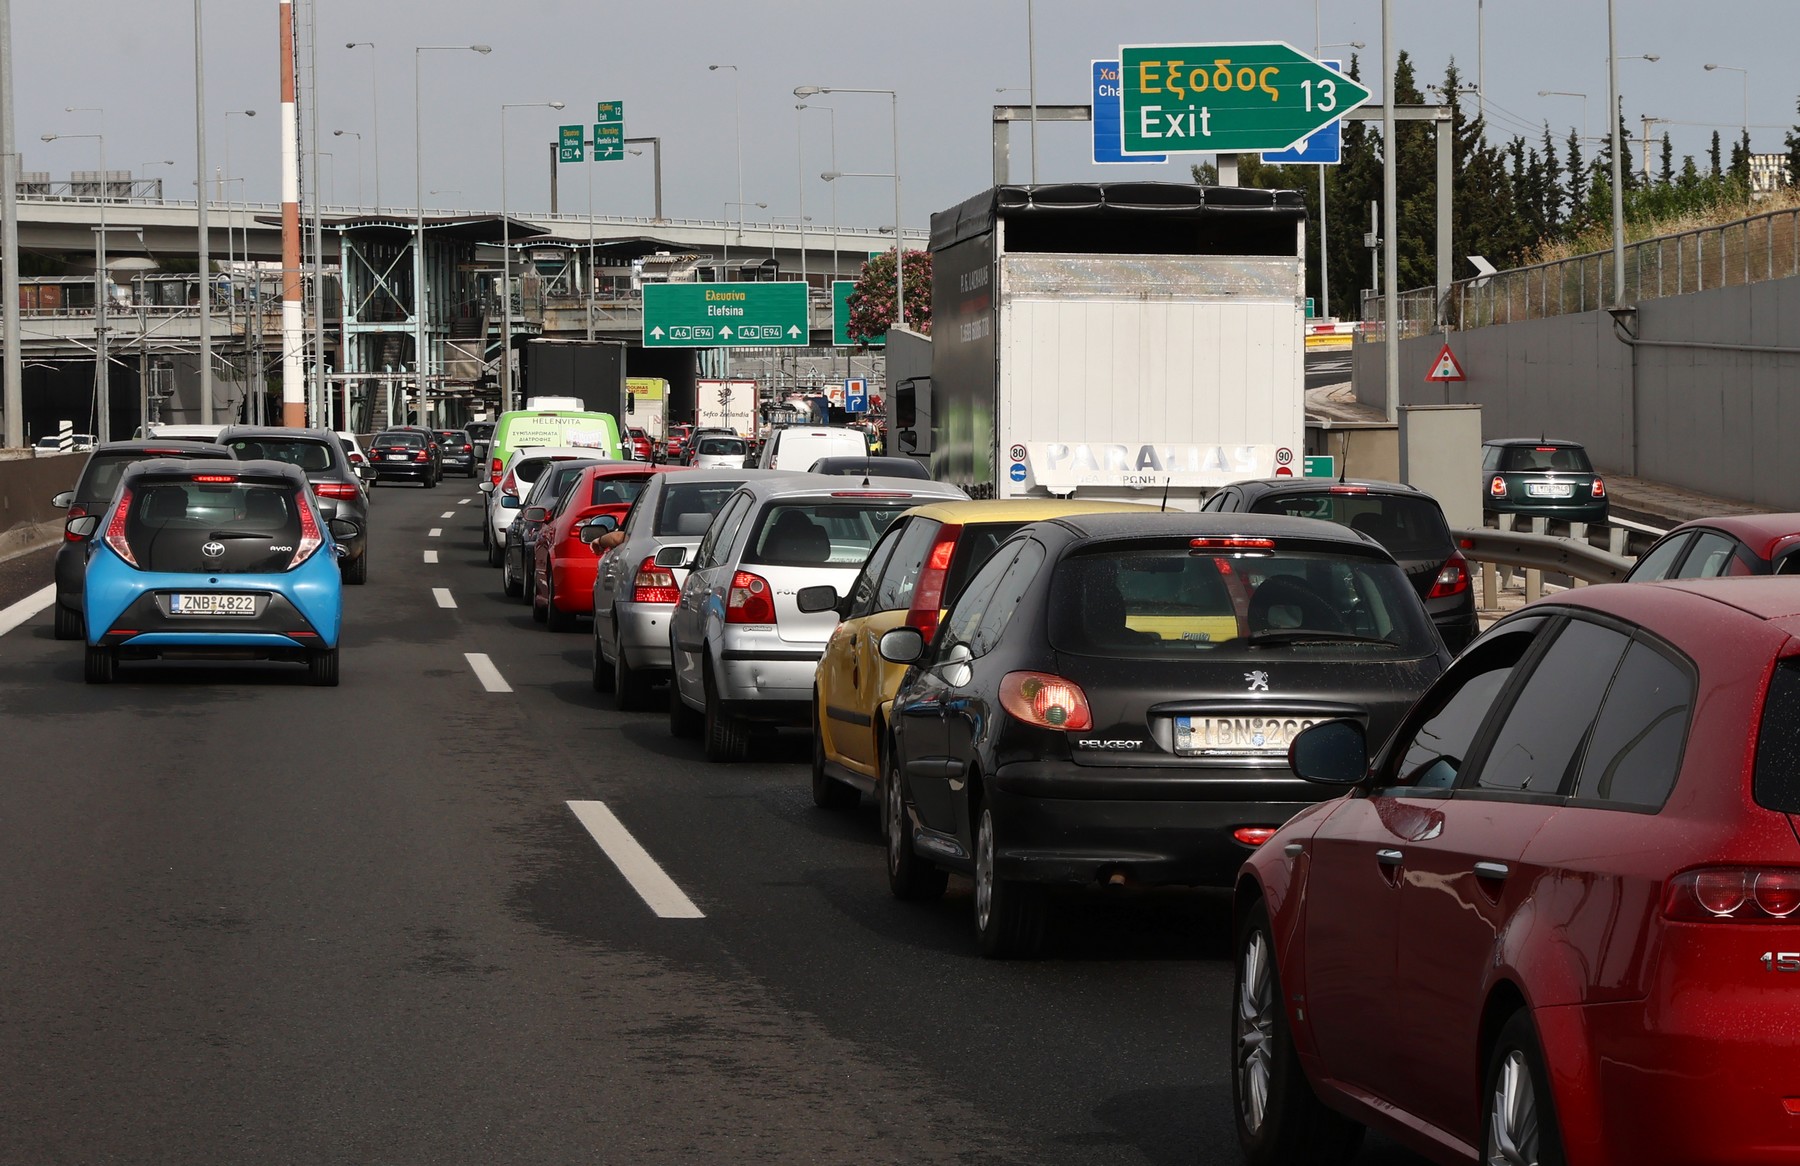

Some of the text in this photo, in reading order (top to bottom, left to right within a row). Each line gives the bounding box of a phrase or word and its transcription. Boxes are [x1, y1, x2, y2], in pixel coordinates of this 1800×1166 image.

[1139, 59, 1280, 102] Εξοδος
[1300, 79, 1337, 113] 13
[615, 107, 621, 115] 12
[1140, 105, 1212, 138] Exit
[705, 289, 746, 301] Ελευσίνα
[708, 305, 744, 316] Elefsina
[674, 327, 779, 337] A6 E94 A6 E94
[1012, 448, 1024, 458] 80
[1278, 451, 1290, 461] 90
[1079, 740, 1143, 749] PEUGEOT
[1760, 951, 1800, 972] 15
